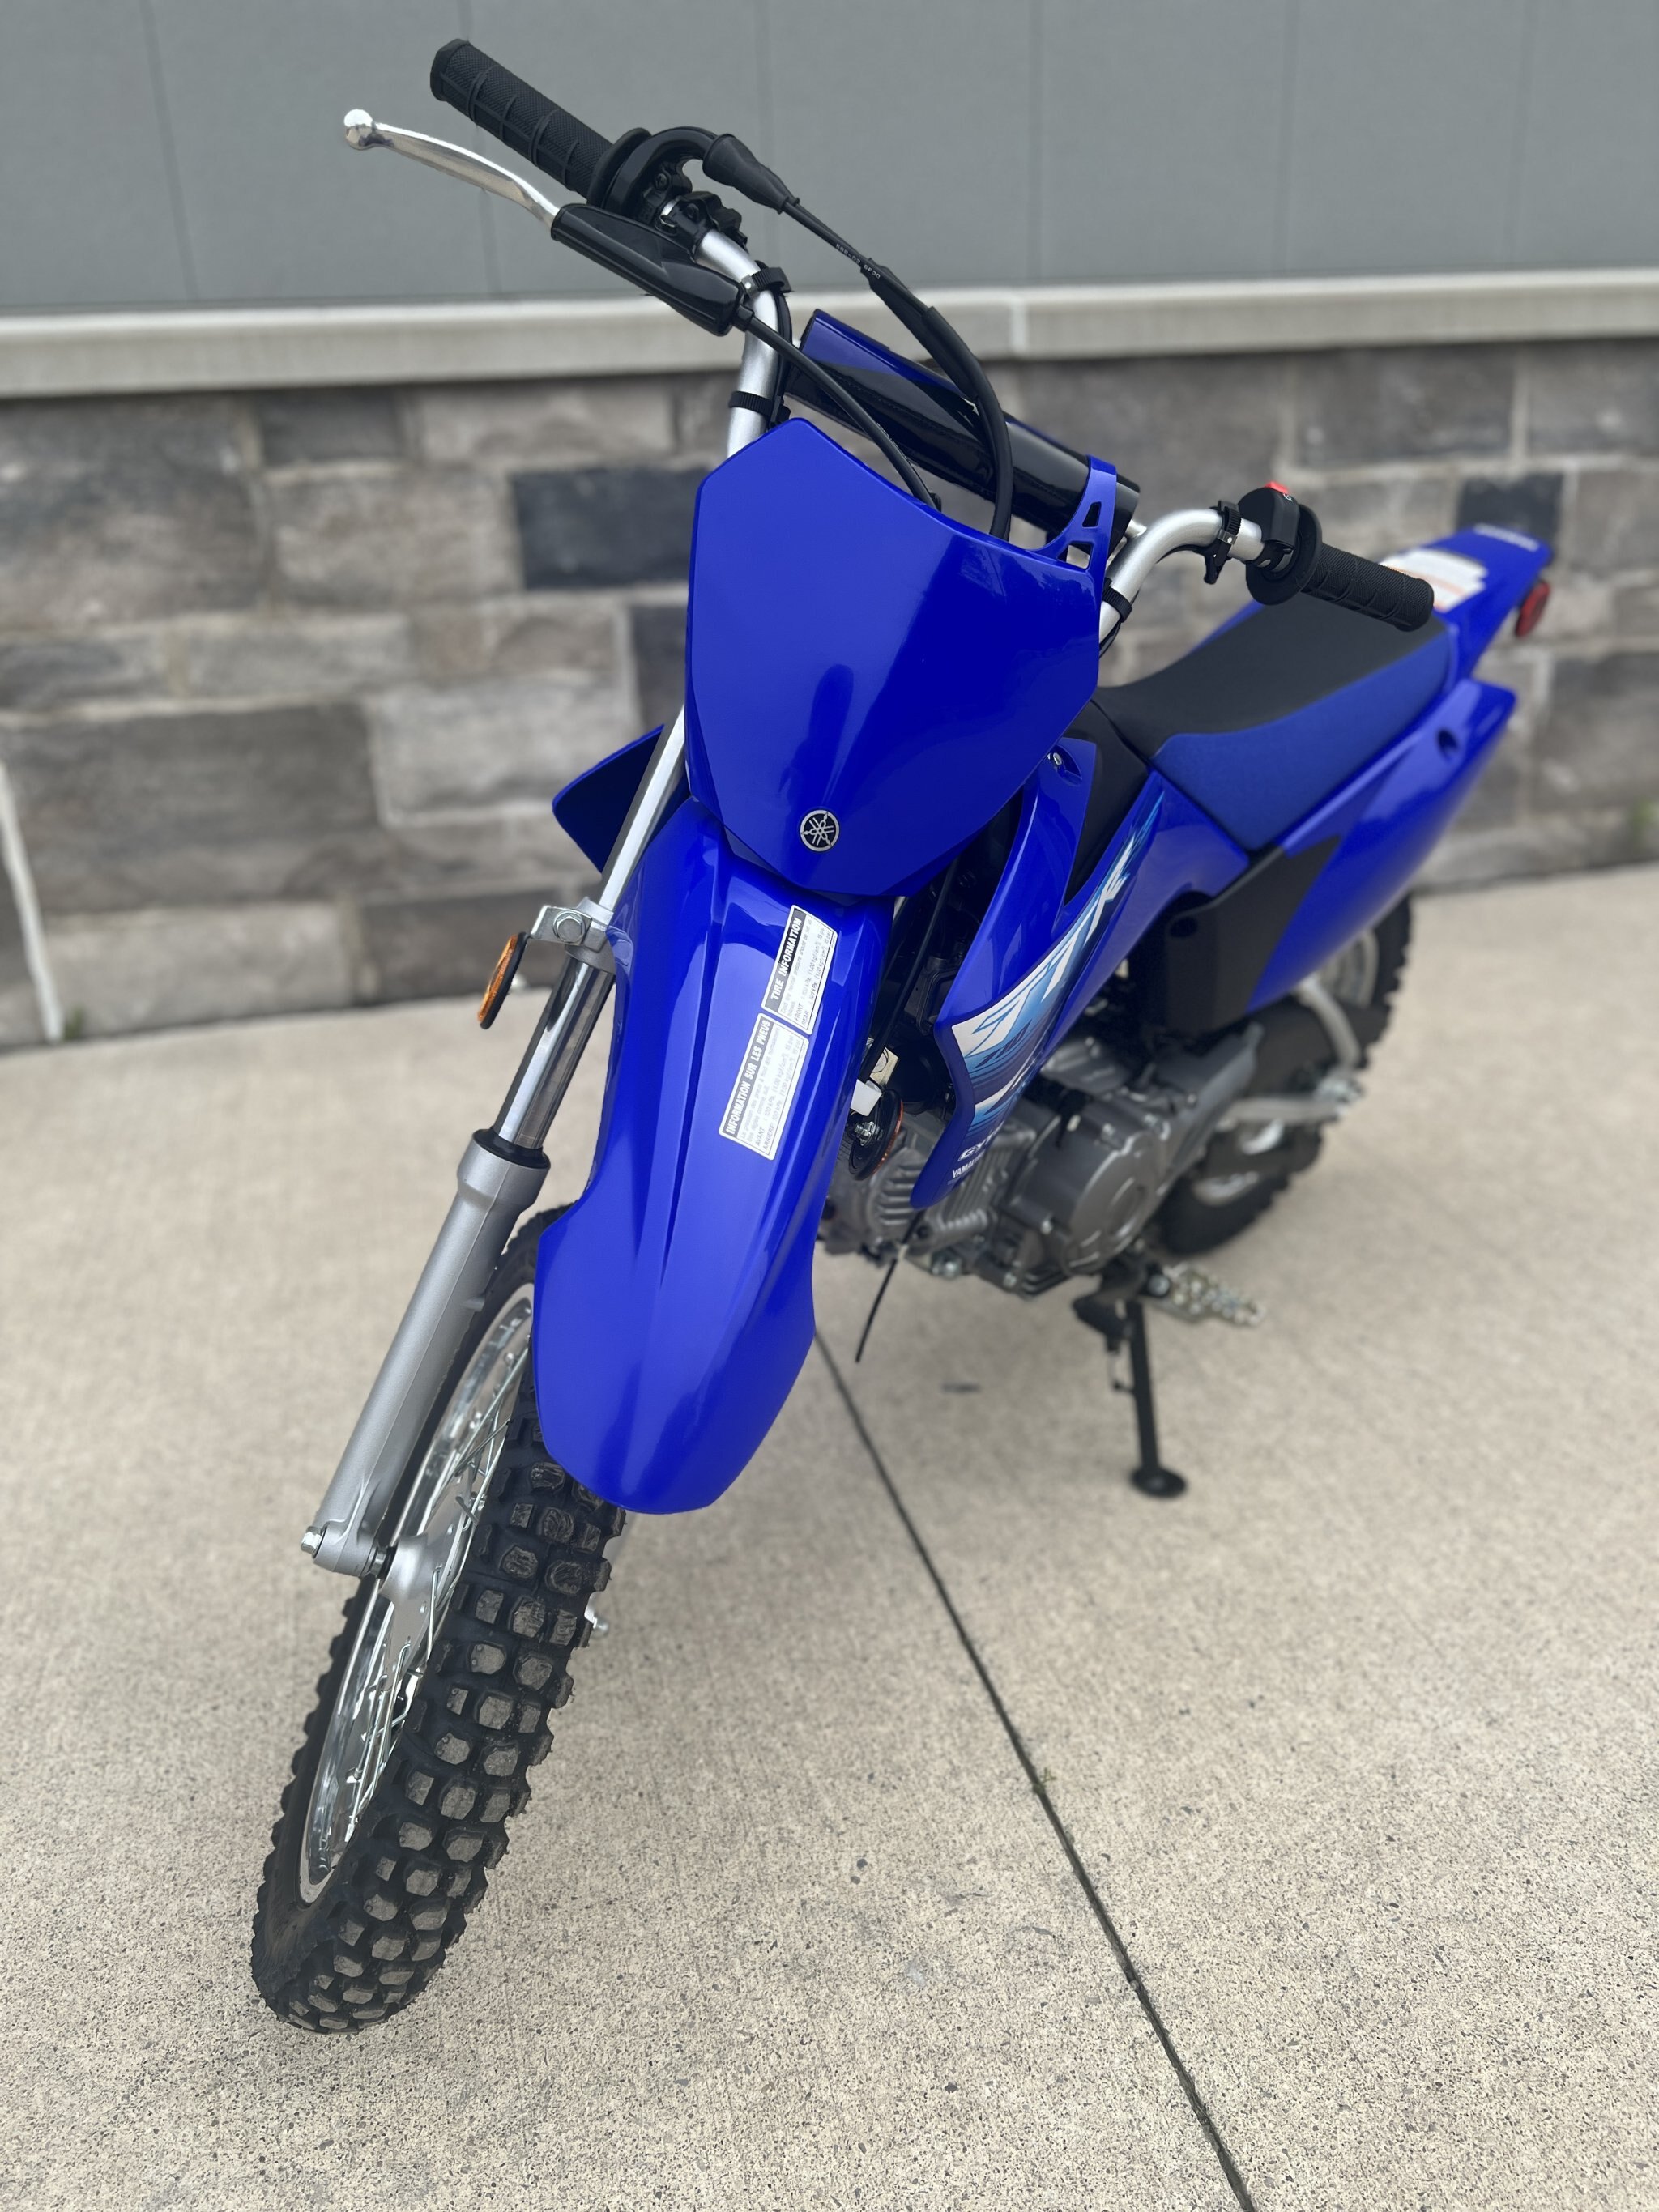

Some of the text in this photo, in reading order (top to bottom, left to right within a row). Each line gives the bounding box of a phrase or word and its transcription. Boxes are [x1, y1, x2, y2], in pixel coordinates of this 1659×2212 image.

[771, 917, 803, 1003] TIRE INFORMATION
[756, 1020, 771, 1046] PNEUS
[751, 1045, 762, 1062] LES
[744, 1062, 757, 1080] SUR
[726, 1080, 751, 1136] INFORMATION
